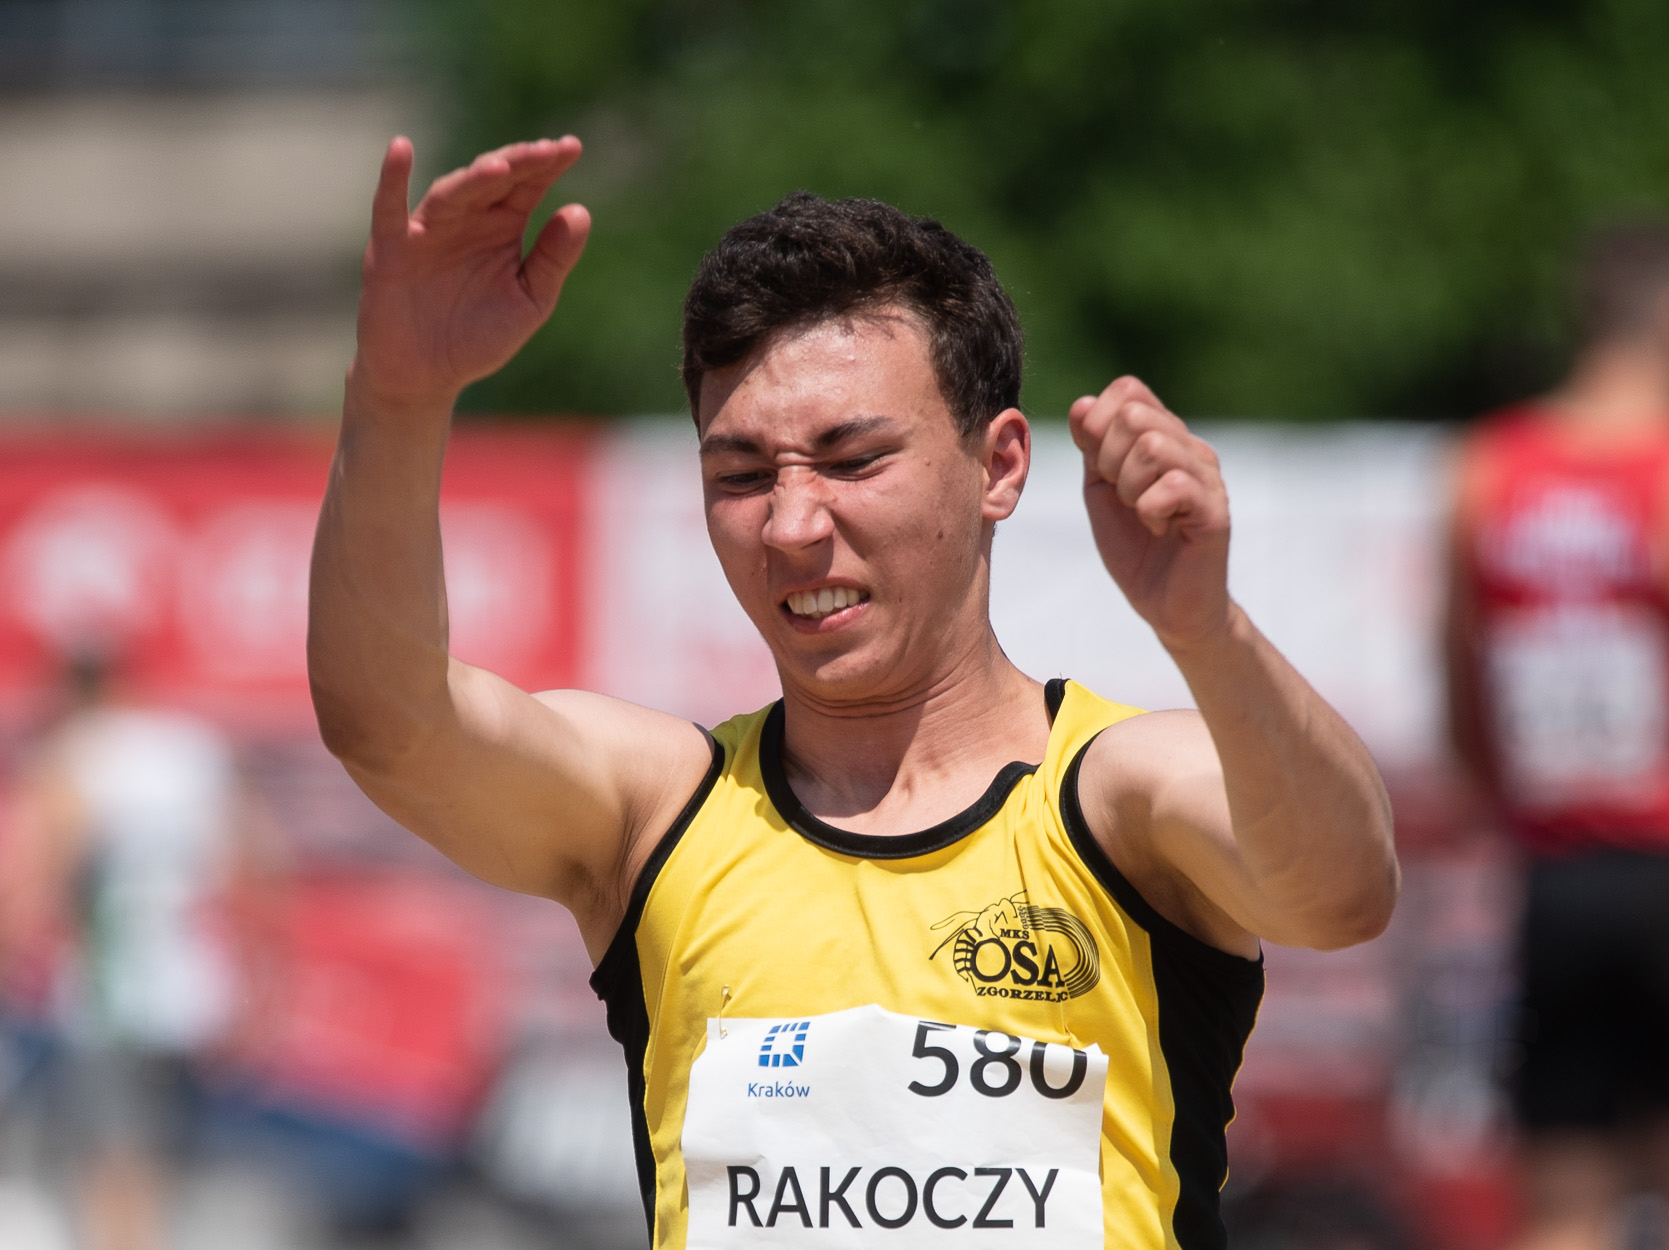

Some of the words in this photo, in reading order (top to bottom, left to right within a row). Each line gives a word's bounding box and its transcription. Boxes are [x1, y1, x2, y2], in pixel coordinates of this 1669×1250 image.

[999, 928, 1030, 940] MKS
[971, 938, 1065, 988] OSA
[908, 1020, 1088, 1100] 580
[747, 1081, 811, 1099] Kraków
[726, 1165, 1060, 1230] RAKOCZY
